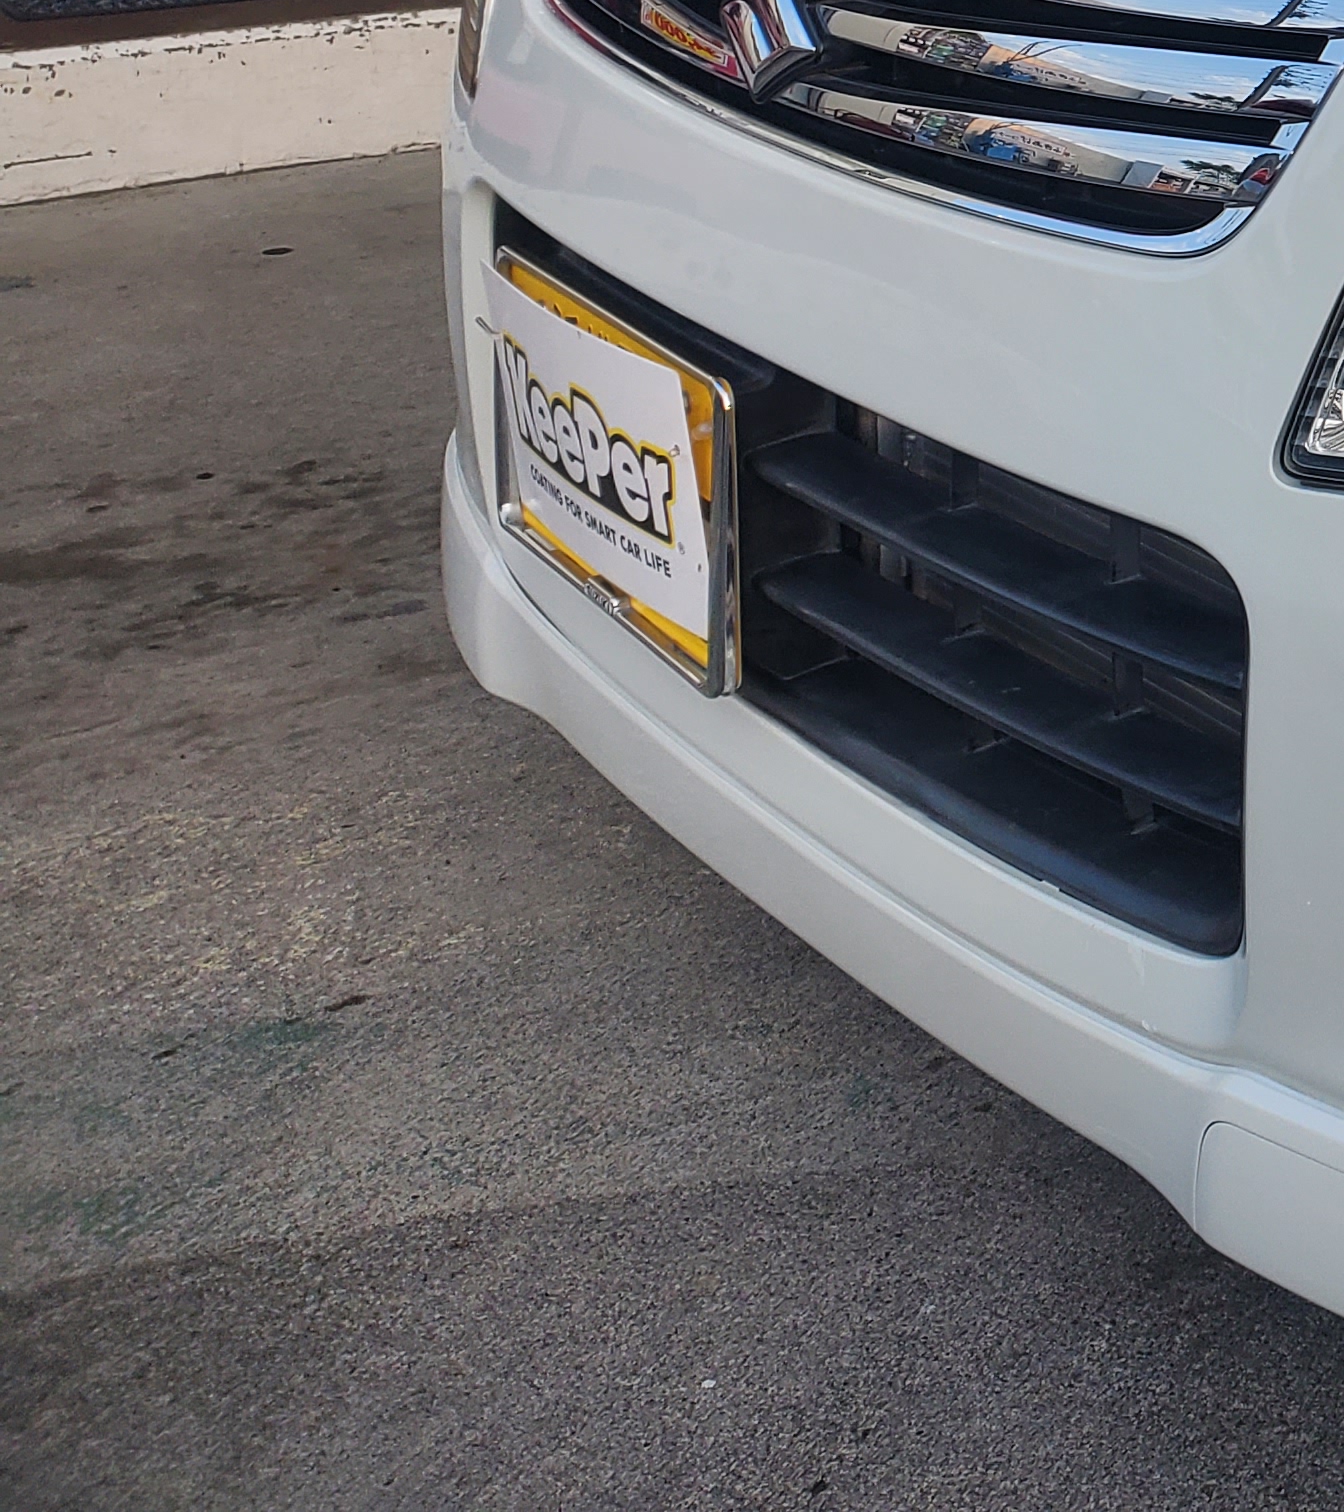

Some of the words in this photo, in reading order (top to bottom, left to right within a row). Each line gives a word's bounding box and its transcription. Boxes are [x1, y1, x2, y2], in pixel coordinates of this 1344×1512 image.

[502, 333, 675, 543] KeePer
[530, 463, 565, 507] COATING
[563, 493, 584, 522] FOR
[584, 505, 618, 550] SMART
[620, 533, 643, 563] CAR
[645, 547, 673, 580] LIFE
